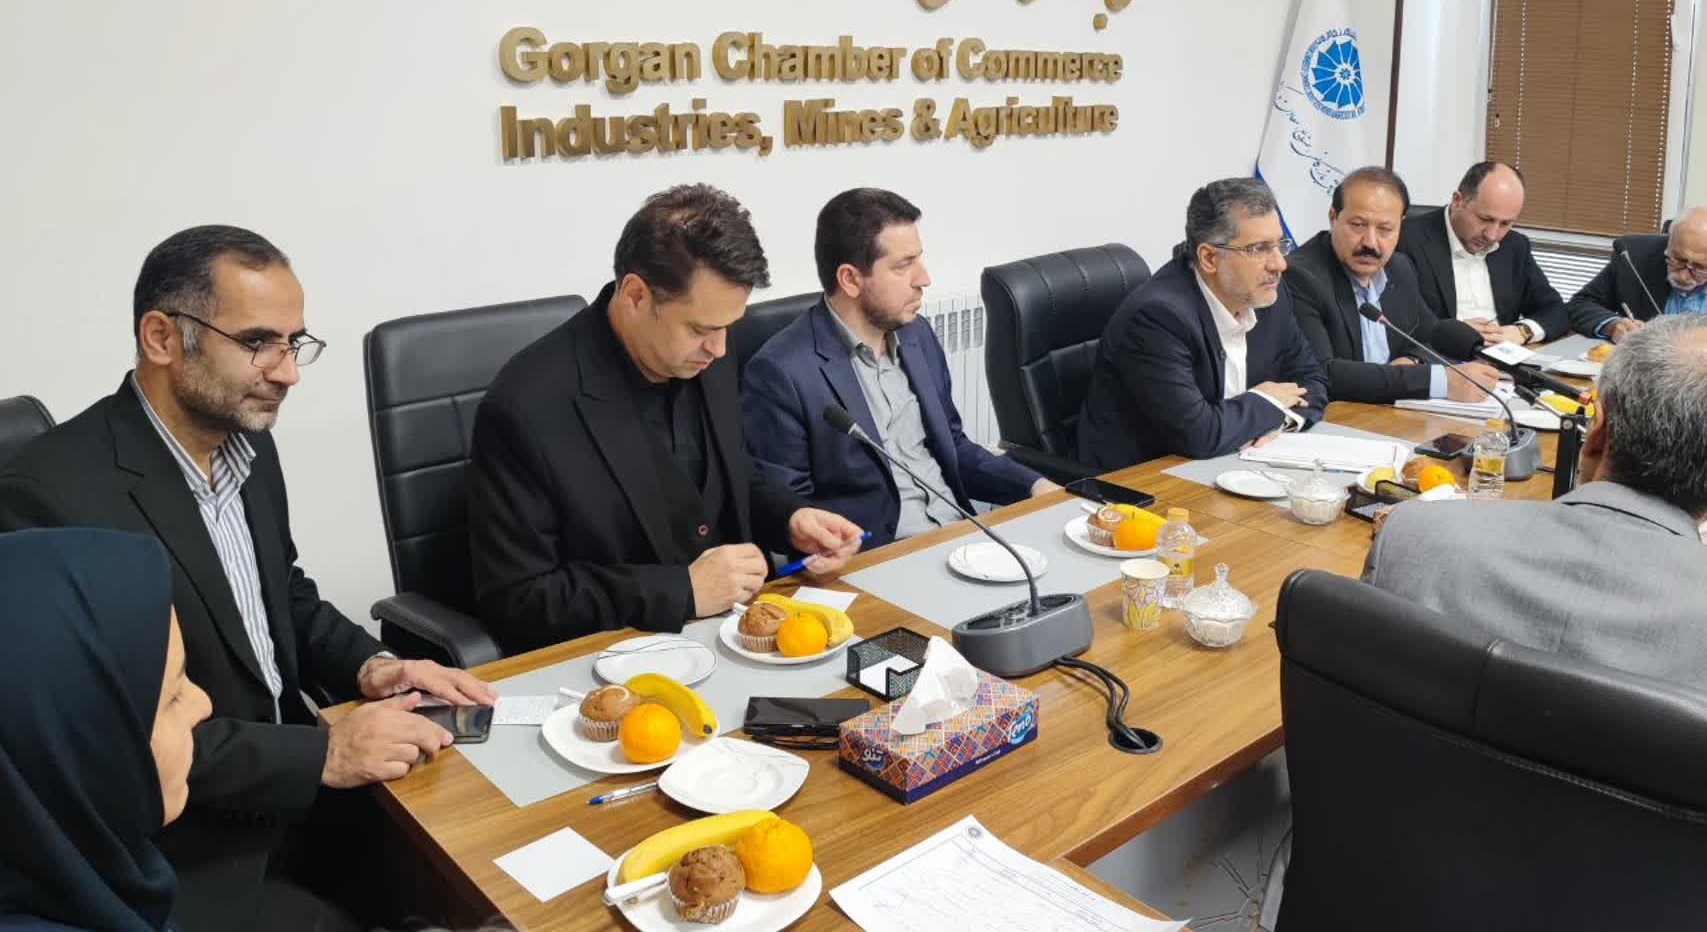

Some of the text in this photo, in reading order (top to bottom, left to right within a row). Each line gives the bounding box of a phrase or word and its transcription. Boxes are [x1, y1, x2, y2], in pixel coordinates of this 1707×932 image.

[500, 27, 1123, 93] Gorgan Chamber of Commerce
[500, 95, 1119, 159] Industries, Mines & Agriculture
